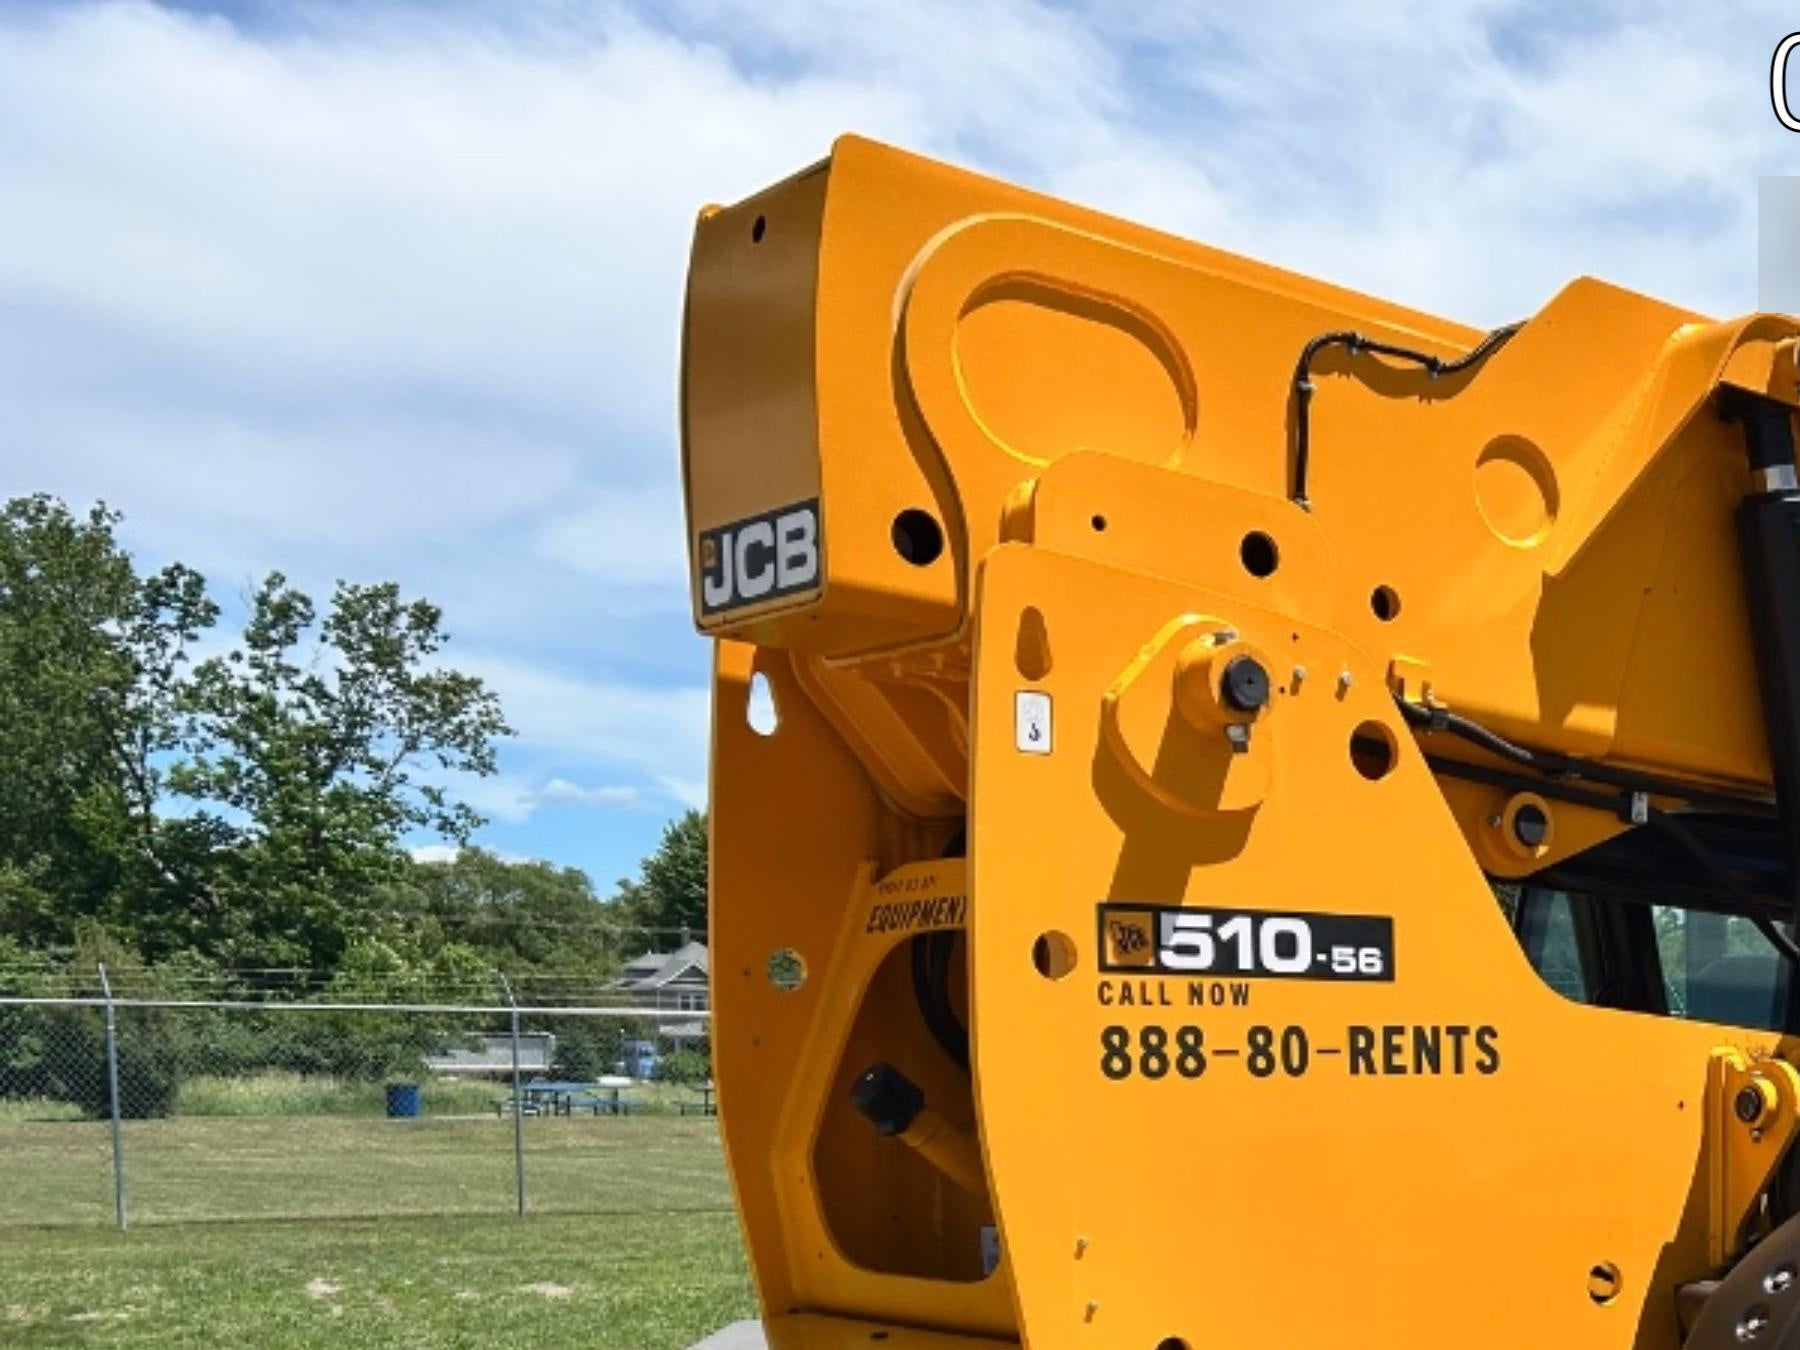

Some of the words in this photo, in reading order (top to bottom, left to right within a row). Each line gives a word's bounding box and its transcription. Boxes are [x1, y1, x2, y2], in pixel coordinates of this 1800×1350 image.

[704, 509, 817, 607] JCB
[1159, 911, 1384, 974] 510-56
[1097, 981, 1172, 1006] CALL
[1187, 982, 1251, 1006] NOW
[1100, 1024, 1501, 1080] 888-80-RENTS
